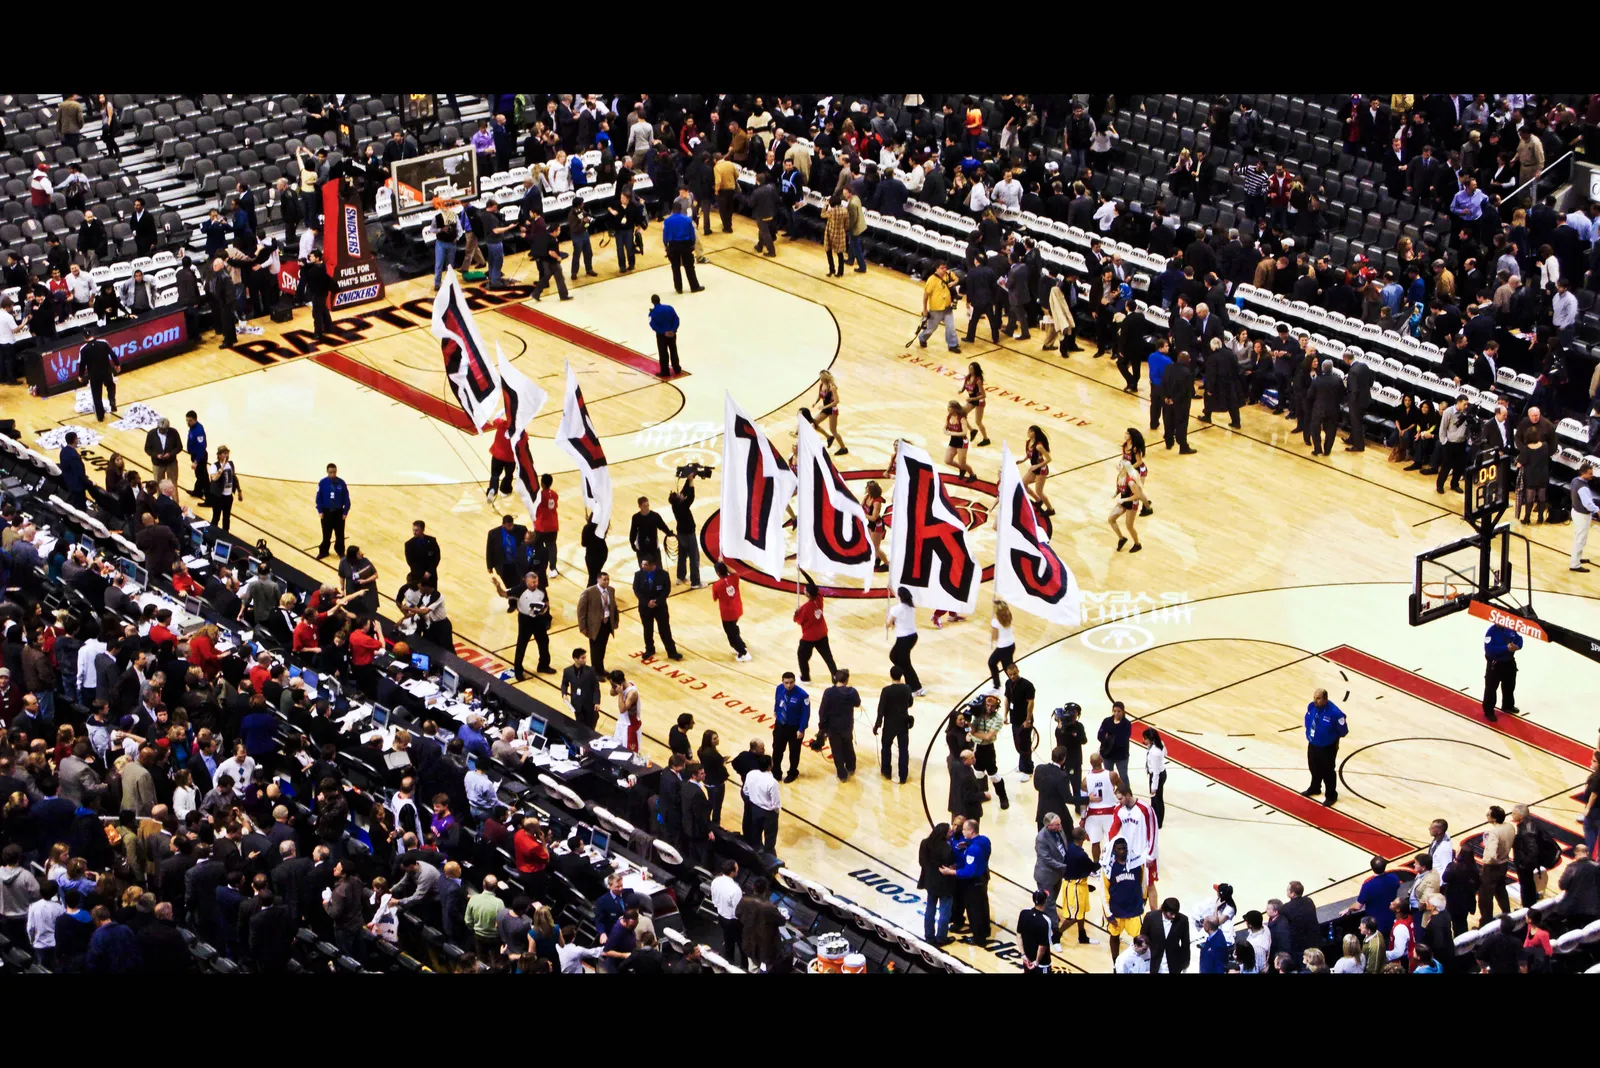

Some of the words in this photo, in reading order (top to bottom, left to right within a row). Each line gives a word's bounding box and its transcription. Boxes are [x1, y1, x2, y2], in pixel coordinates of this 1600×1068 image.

[346, 207, 359, 254] SNICKERS
[340, 267, 356, 277] FUEL
[357, 264, 370, 274] FOR
[360, 273, 377, 283] NEXT.
[336, 286, 377, 304] SNICKERS
[1053, 412, 1092, 427] AIR
[1489, 610, 1515, 630] State
[1515, 619, 1541, 638] Farm
